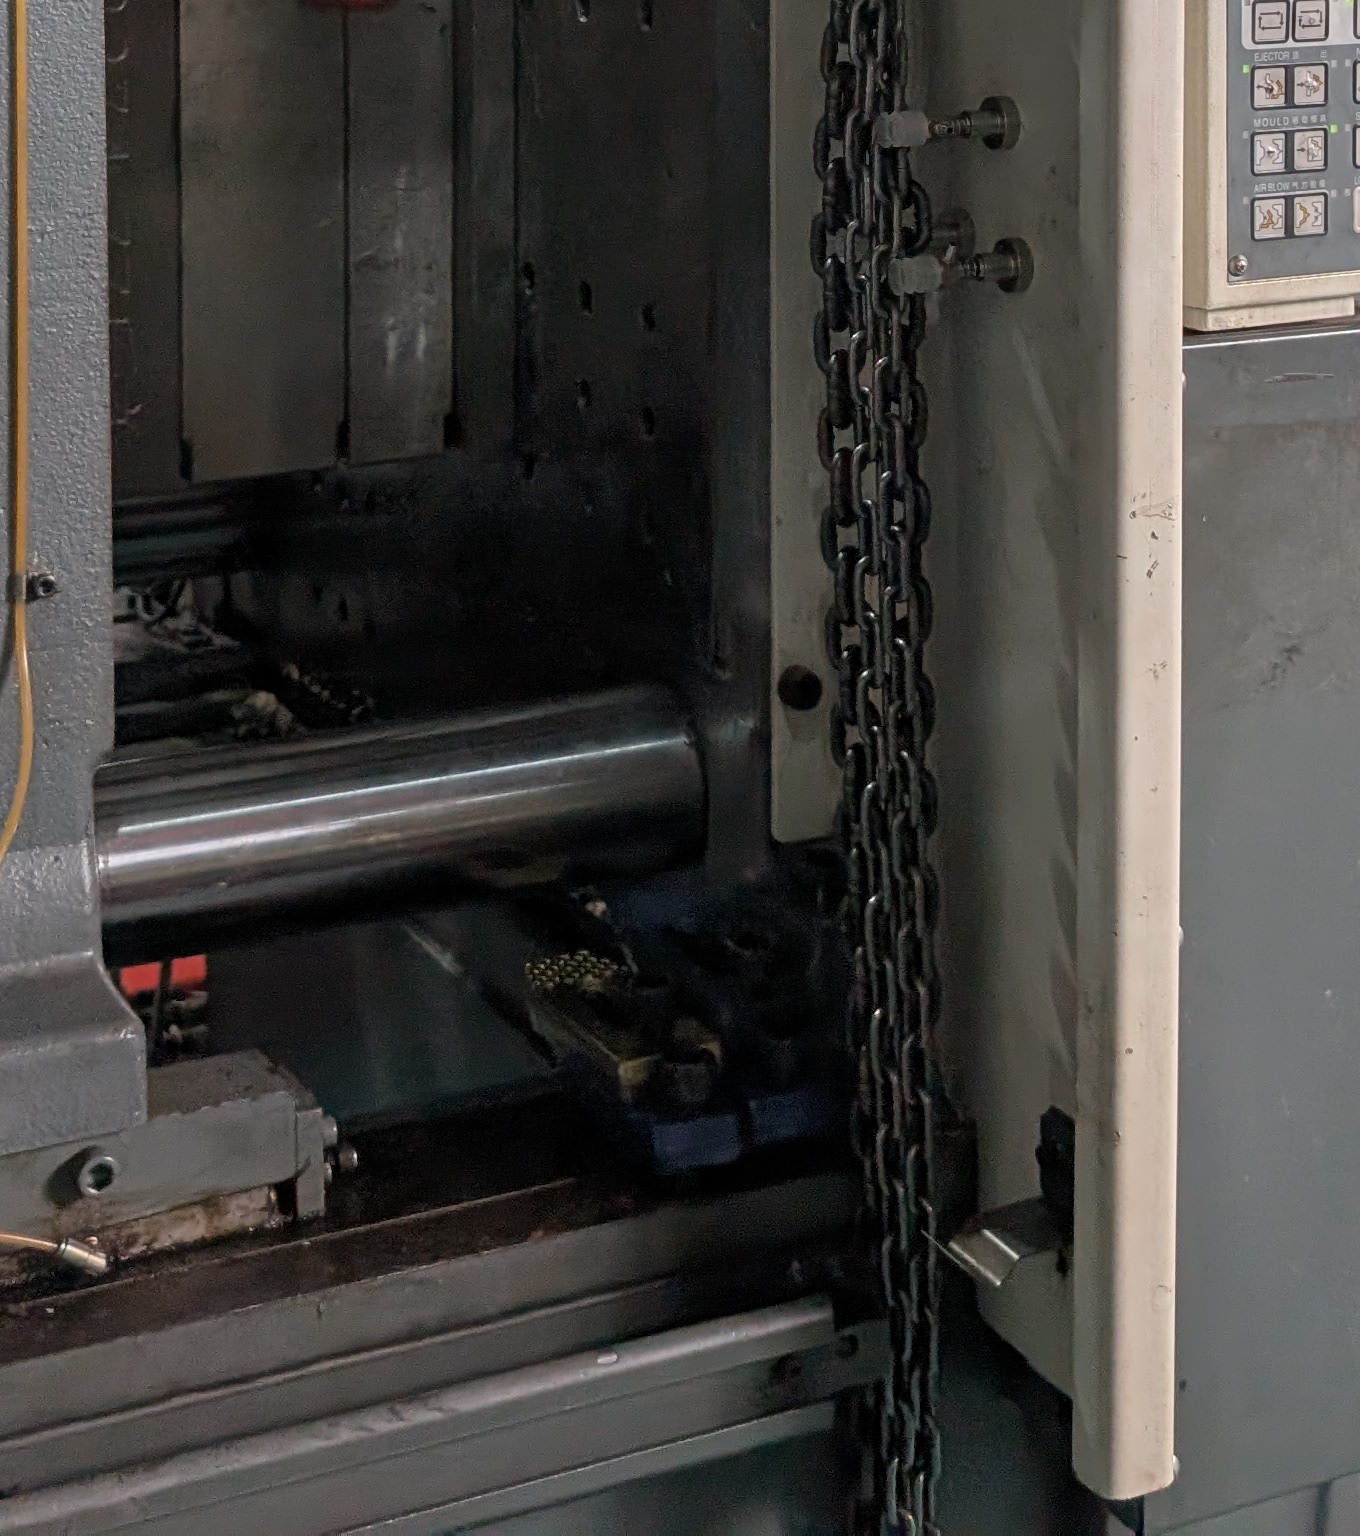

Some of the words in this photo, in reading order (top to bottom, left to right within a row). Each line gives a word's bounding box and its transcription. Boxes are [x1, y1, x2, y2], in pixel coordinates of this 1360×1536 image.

[1254, 52, 1290, 62] EJECTOR
[1254, 116, 1289, 128] MOULD
[1254, 183, 1267, 193] AIR
[1268, 181, 1289, 192] BLOW
